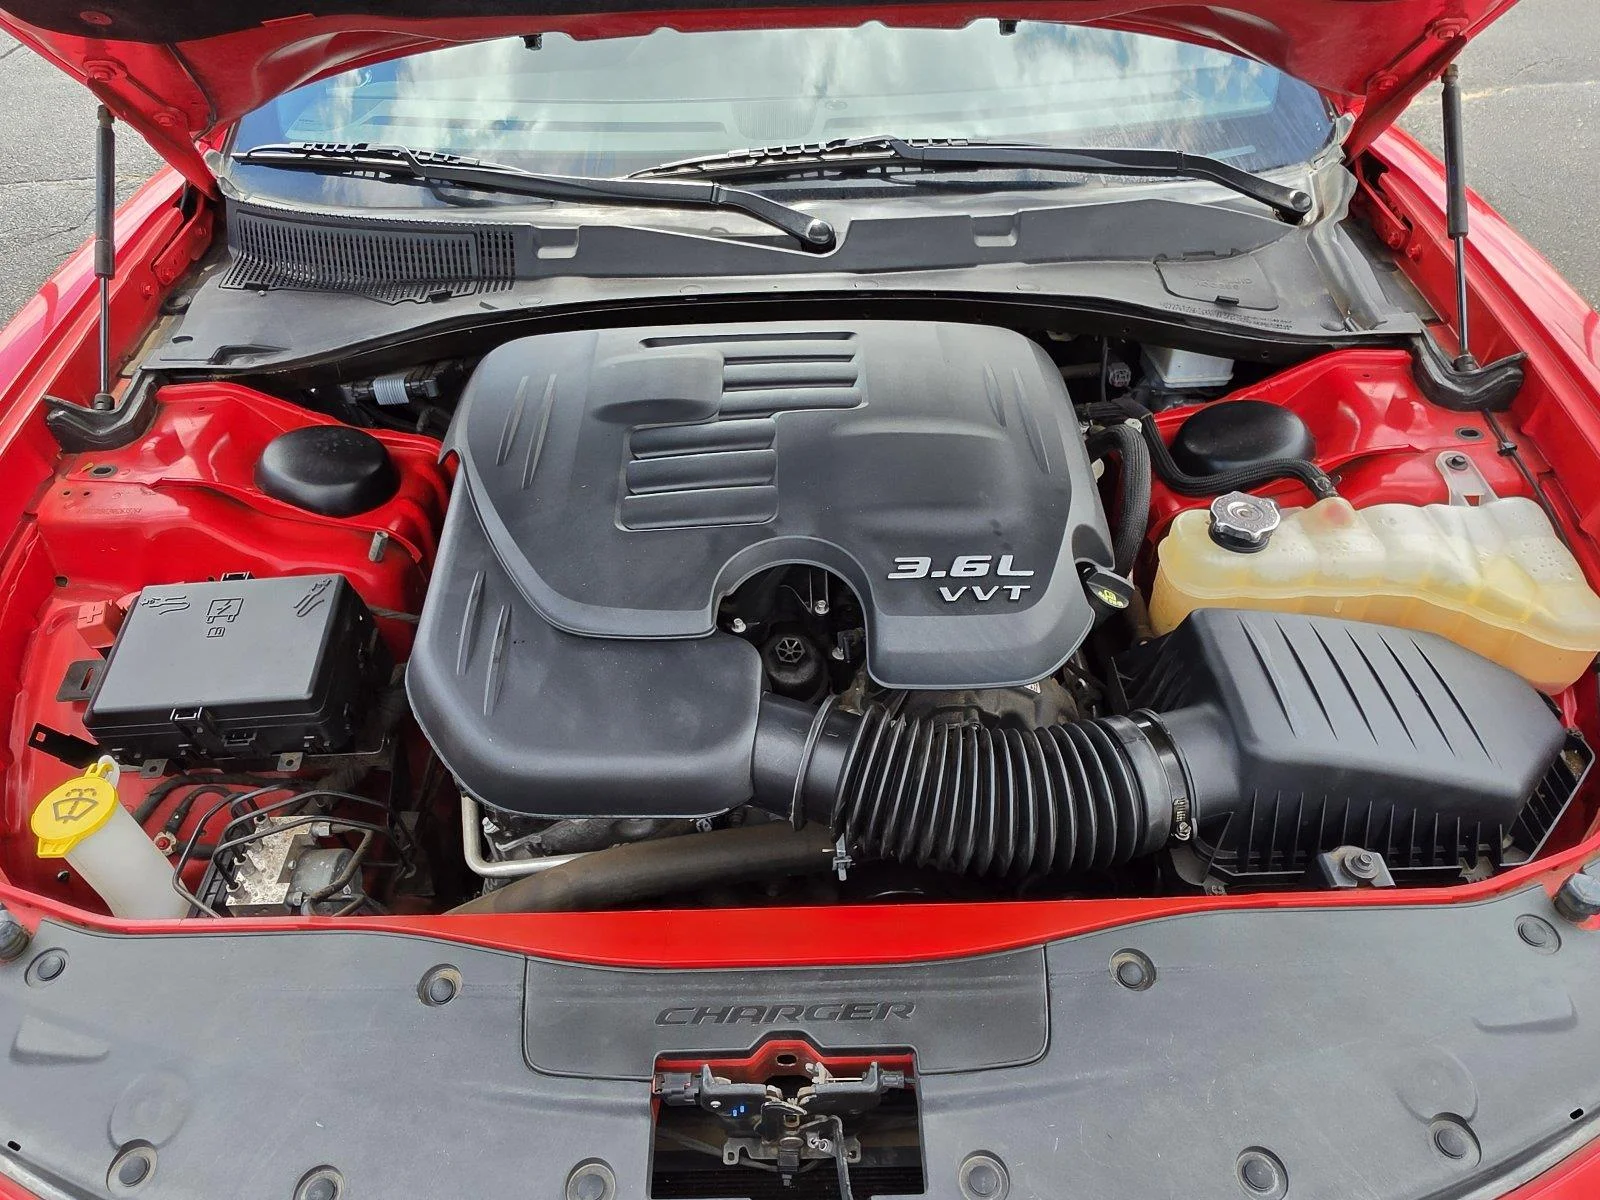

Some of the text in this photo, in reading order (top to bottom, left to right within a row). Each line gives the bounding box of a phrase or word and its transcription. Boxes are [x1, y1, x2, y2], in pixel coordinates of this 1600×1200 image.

[887, 554, 1035, 579] 3.6L
[938, 585, 1031, 602] VVT
[654, 1001, 916, 1026] CHARGER
